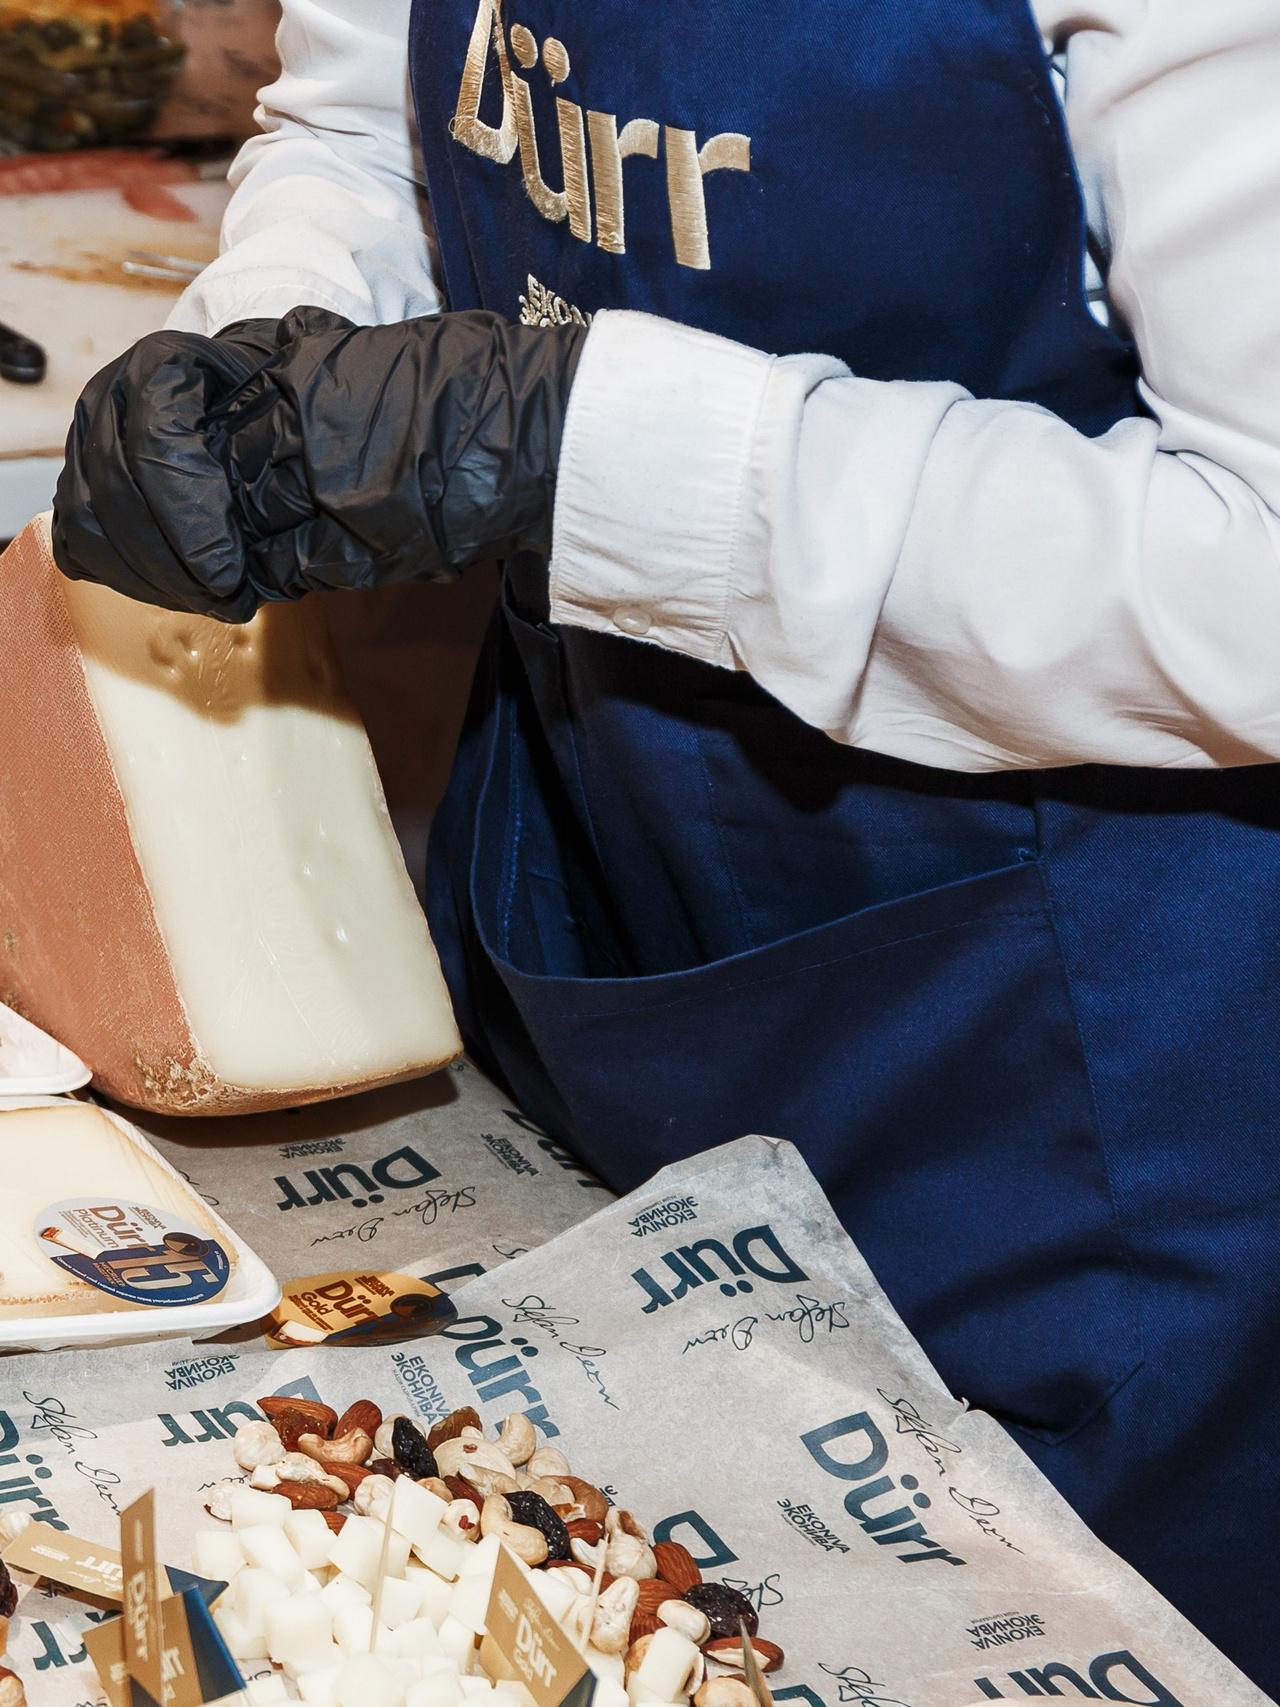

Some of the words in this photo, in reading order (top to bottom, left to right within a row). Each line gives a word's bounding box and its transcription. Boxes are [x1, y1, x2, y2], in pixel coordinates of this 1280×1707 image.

[449, 0, 751, 270] Dürr
[274, 1145, 443, 1211] Dürr
[73, 1208, 120, 1249] Platinum
[88, 1205, 157, 1252] Dürr
[627, 1195, 699, 1228] ЭКОНИВА
[631, 1209, 698, 1238] EKONIVA
[107, 1250, 220, 1291] 15
[631, 1223, 811, 1314] Dürr
[301, 1291, 335, 1316] Gold
[314, 1279, 388, 1327] Dürr
[165, 1363, 238, 1391] EKONIVA
[390, 1351, 439, 1426] ЭКОНИВА
[157, 1401, 269, 1447] ürr
[799, 1411, 968, 1567] Dürr
[777, 1497, 836, 1553] ЭКОНИВА
[797, 1503, 851, 1555] EKONIVA
[966, 1613, 1047, 1639] ЭКОНИВА
[971, 1624, 1047, 1653] EKONIVA
[515, 1613, 558, 1688] Dürr
